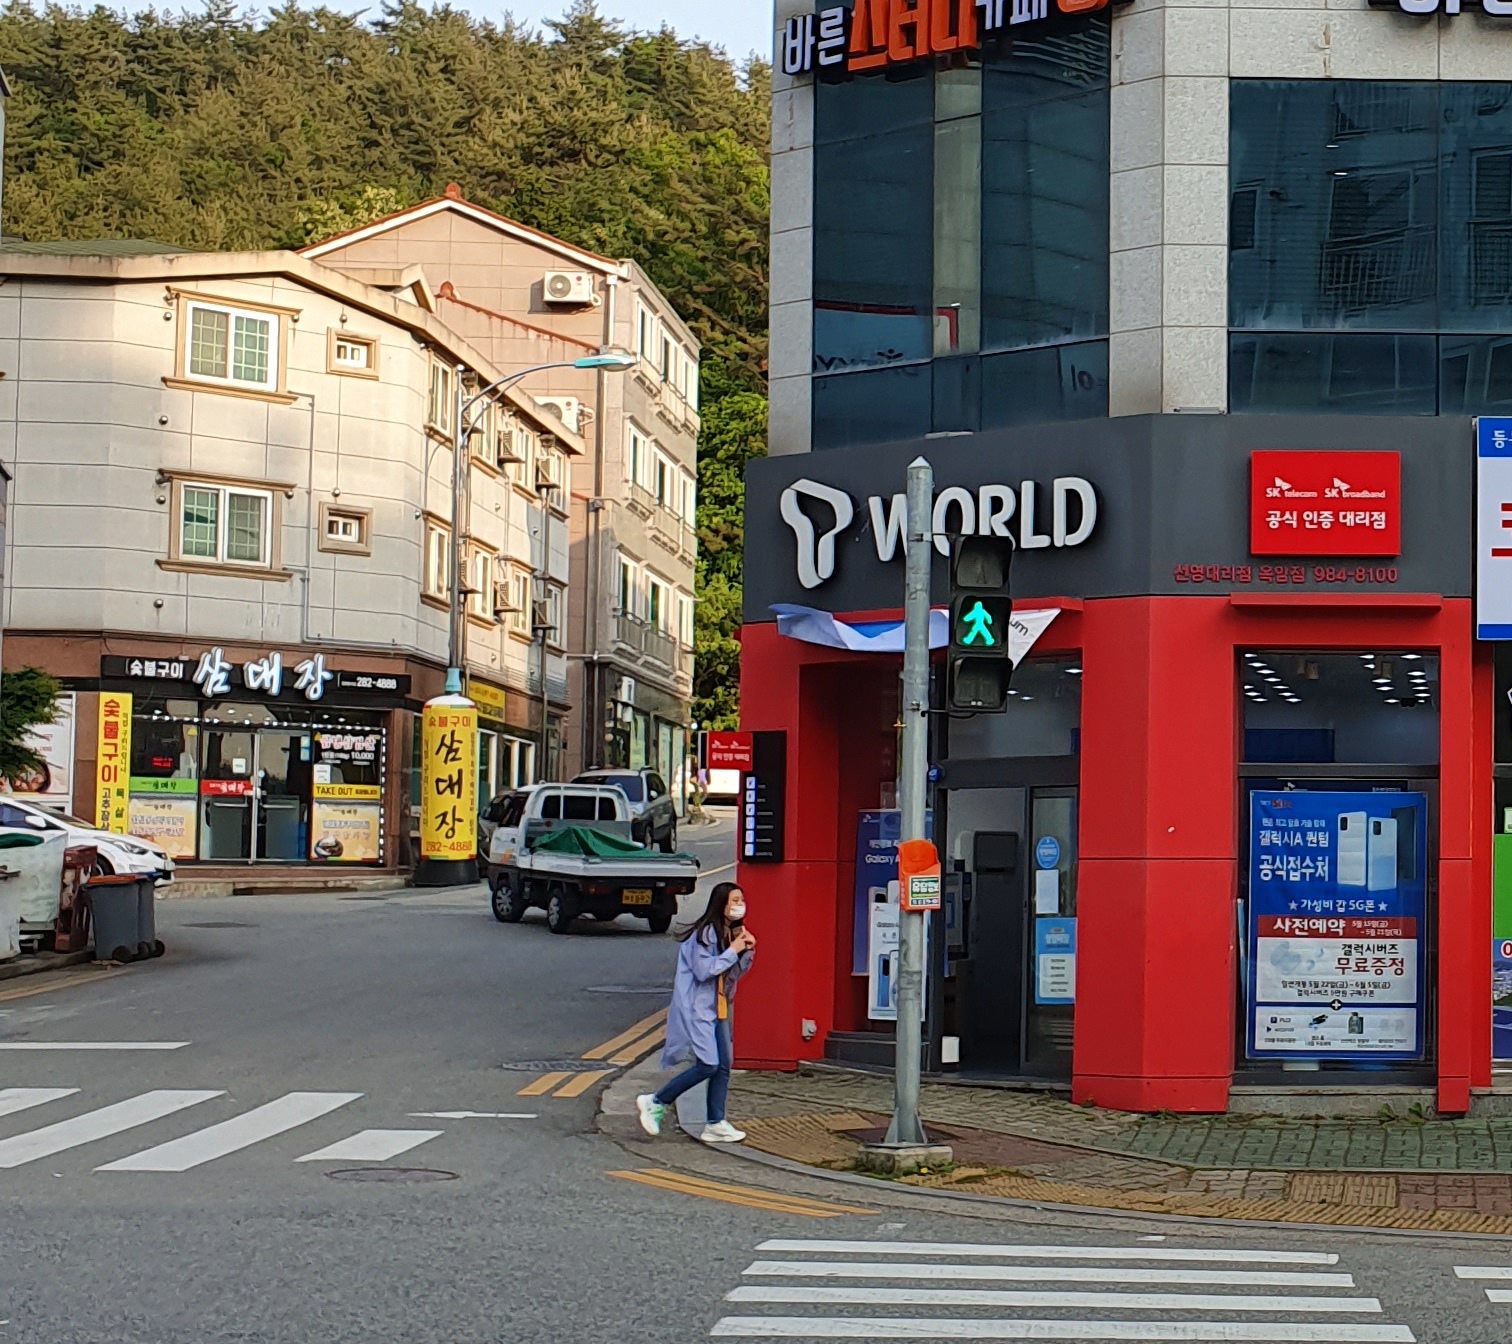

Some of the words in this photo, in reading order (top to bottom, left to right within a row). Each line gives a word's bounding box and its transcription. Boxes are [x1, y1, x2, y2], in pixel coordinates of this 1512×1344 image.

[1265, 486, 1281, 498] SK
[1284, 490, 1318, 498] telecom
[1323, 486, 1340, 498] SK
[1342, 490, 1386, 499] broadband
[868, 477, 1098, 562] WORLD
[1265, 510, 1298, 528] 공식
[1303, 510, 1334, 529] 인증
[1338, 510, 1386, 530] 대리점
[1257, 564, 1305, 584] 옥암점
[1313, 564, 1398, 583] 984-8100
[316, 787, 336, 795] TAKE
[338, 787, 353, 795] OUT
[435, 729, 464, 839] 삼대장
[1259, 830, 1303, 847] 갤럭시A
[1306, 830, 1329, 848] 퀀텀
[1259, 854, 1329, 882] 공식접수처
[1301, 899, 1333, 913] 가성비
[1335, 899, 1347, 913] 갑
[1349, 900, 1375, 913] 5G폰
[1273, 917, 1346, 936] 사전예약
[1341, 943, 1399, 956] 갤럭시버즈
[1335, 957, 1405, 976] 무료증정
